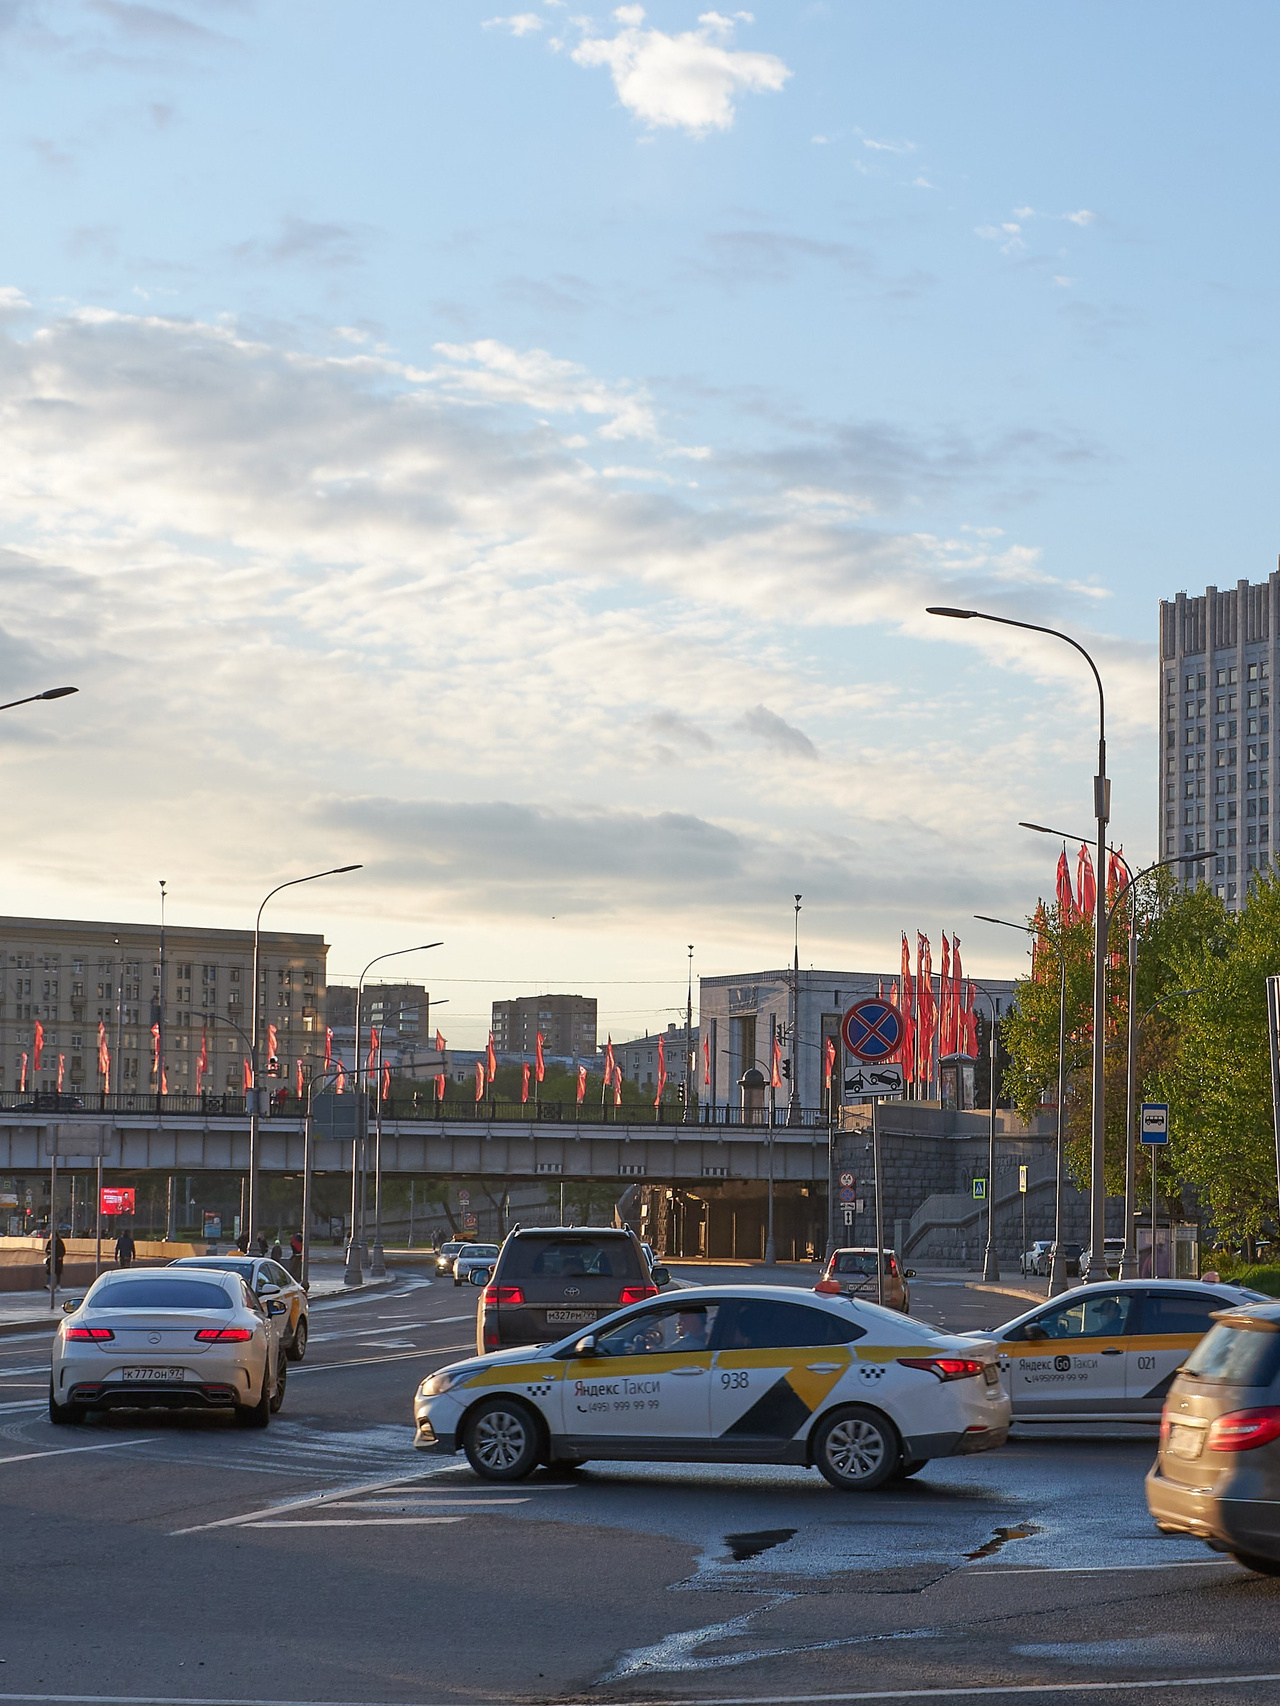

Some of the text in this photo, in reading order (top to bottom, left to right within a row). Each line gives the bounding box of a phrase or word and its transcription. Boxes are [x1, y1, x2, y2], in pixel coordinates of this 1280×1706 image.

[1019, 1357, 1099, 1371] Яндекс Go Такси
[1137, 1356, 1156, 1370] 021
[127, 1369, 167, 1379] К777ОН
[720, 1371, 749, 1390] 938
[1066, 1374, 1076, 1382] 99
[1078, 1373, 1088, 1381] 99
[574, 1378, 661, 1397] Яндекс Такси
[588, 1400, 660, 1413] (495) 999 99 99
